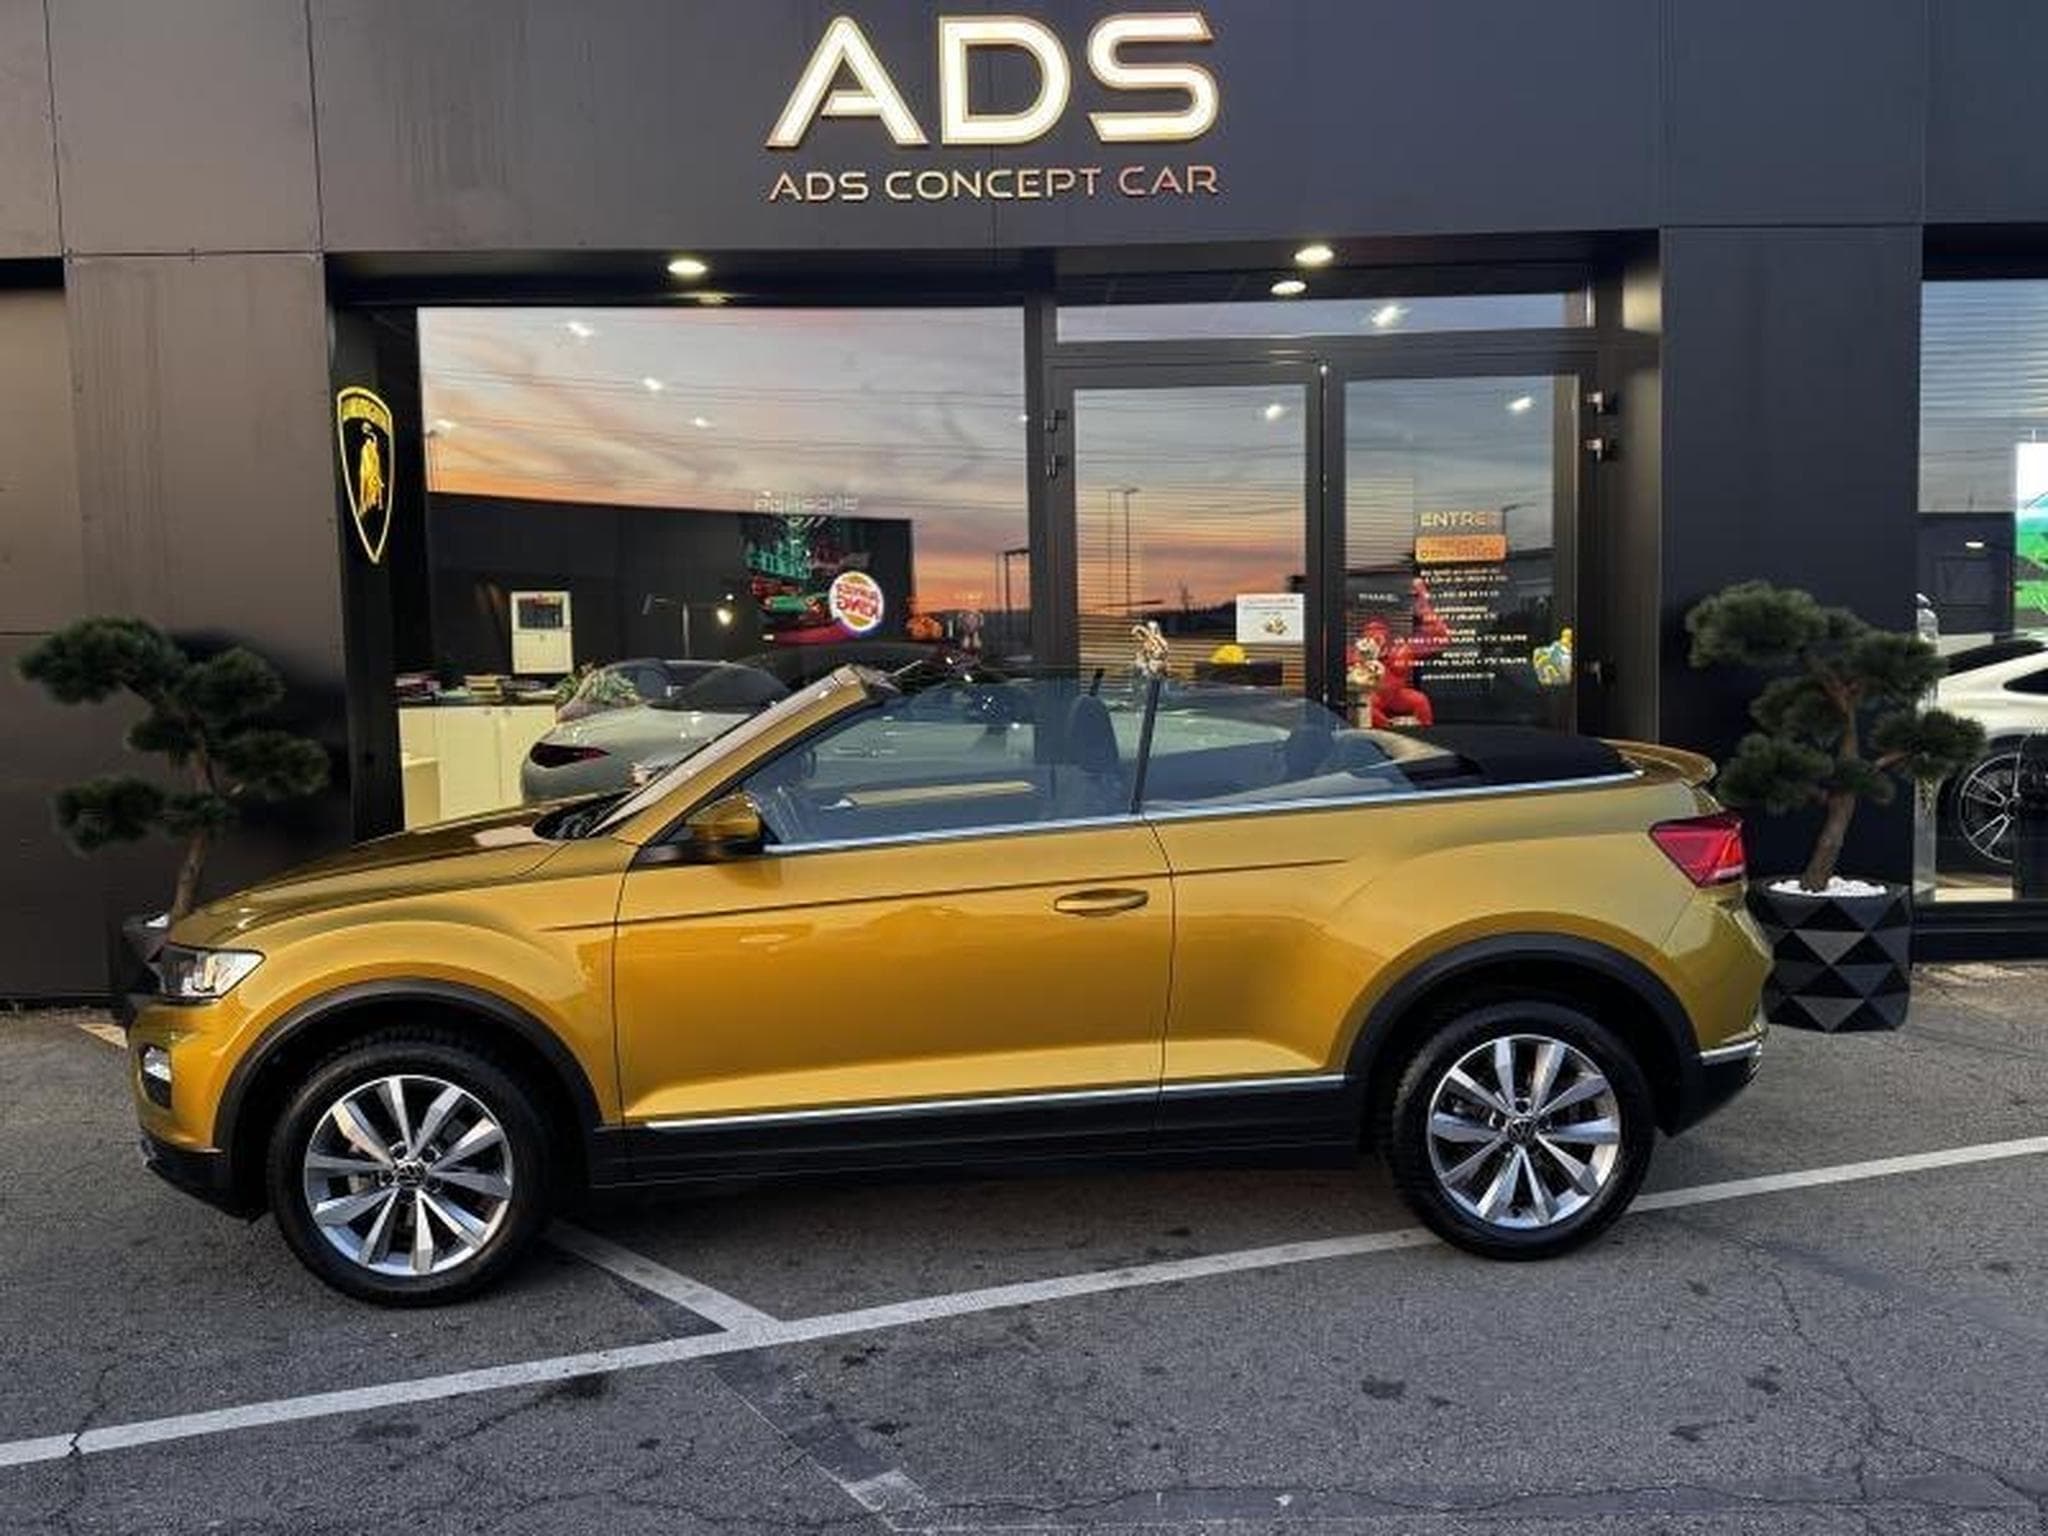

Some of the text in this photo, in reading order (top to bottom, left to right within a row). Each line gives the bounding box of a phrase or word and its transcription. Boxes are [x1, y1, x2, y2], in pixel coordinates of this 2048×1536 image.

[765, 12, 1220, 147] ADS
[768, 165, 1219, 201] ADS CONCEPT CAR
[1420, 511, 1497, 527] ENTRE
